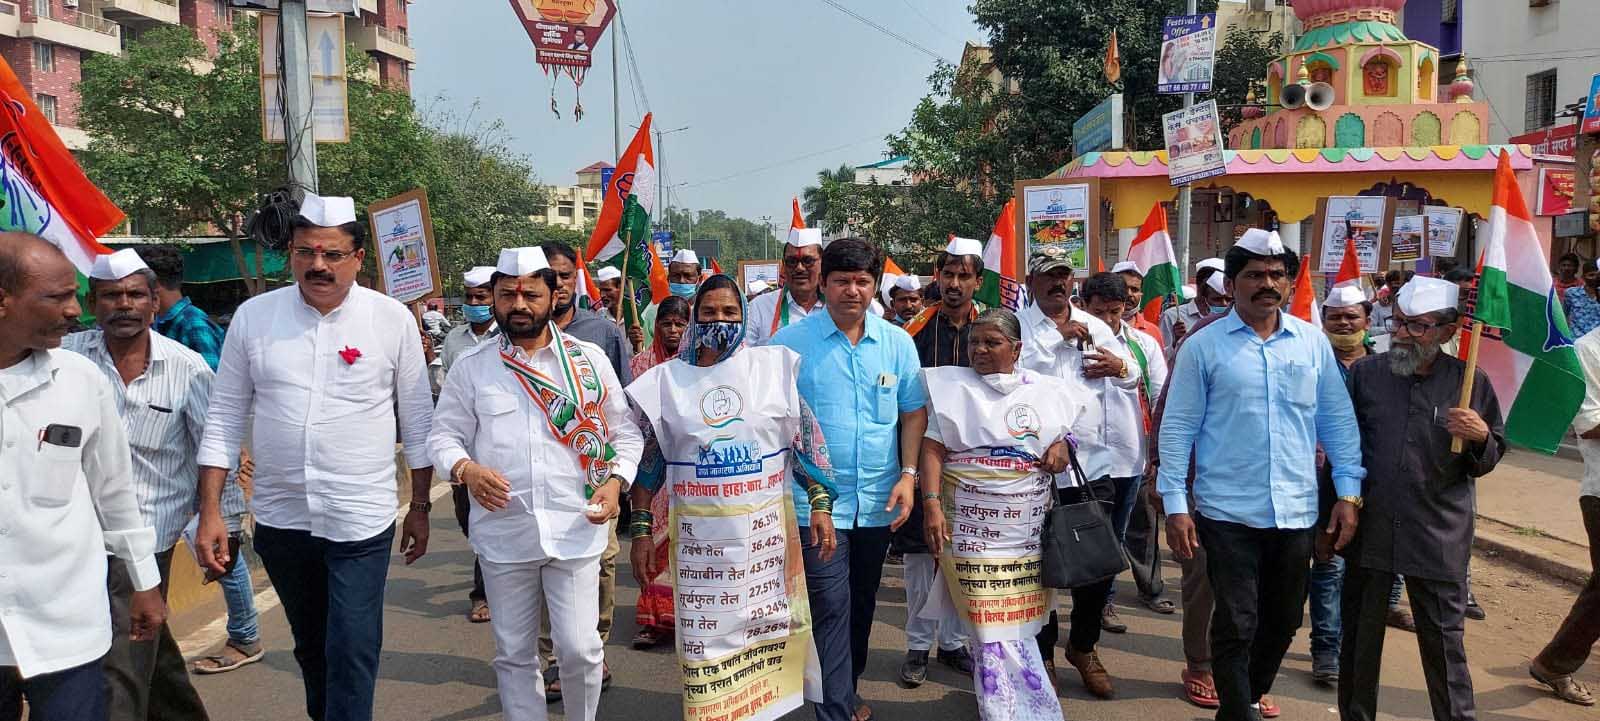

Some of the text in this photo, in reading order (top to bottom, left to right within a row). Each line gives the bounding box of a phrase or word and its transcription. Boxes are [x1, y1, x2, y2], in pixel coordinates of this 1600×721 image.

[1166, 15, 1196, 26] Festival
[1171, 27, 1190, 37] Offer
[751, 511, 779, 532] 26.31%
[960, 504, 999, 521] सूर्यफुल
[1003, 507, 1021, 519] तेल
[959, 523, 1000, 539] पाम तेल
[705, 543, 725, 557] तेल
[751, 534, 784, 554] 36.42%
[679, 554, 783, 581] सोयाबीन तेल 43.75%
[983, 563, 999, 575] एक
[719, 592, 739, 605] तेल
[748, 578, 781, 599] 27.51%
[989, 579, 1010, 592] दरात
[698, 617, 718, 630] तेल
[750, 600, 788, 622] 29.24%
[746, 622, 789, 640] 28.26%
[710, 676, 733, 694] दरात
[733, 657, 765, 682] कमालीची
